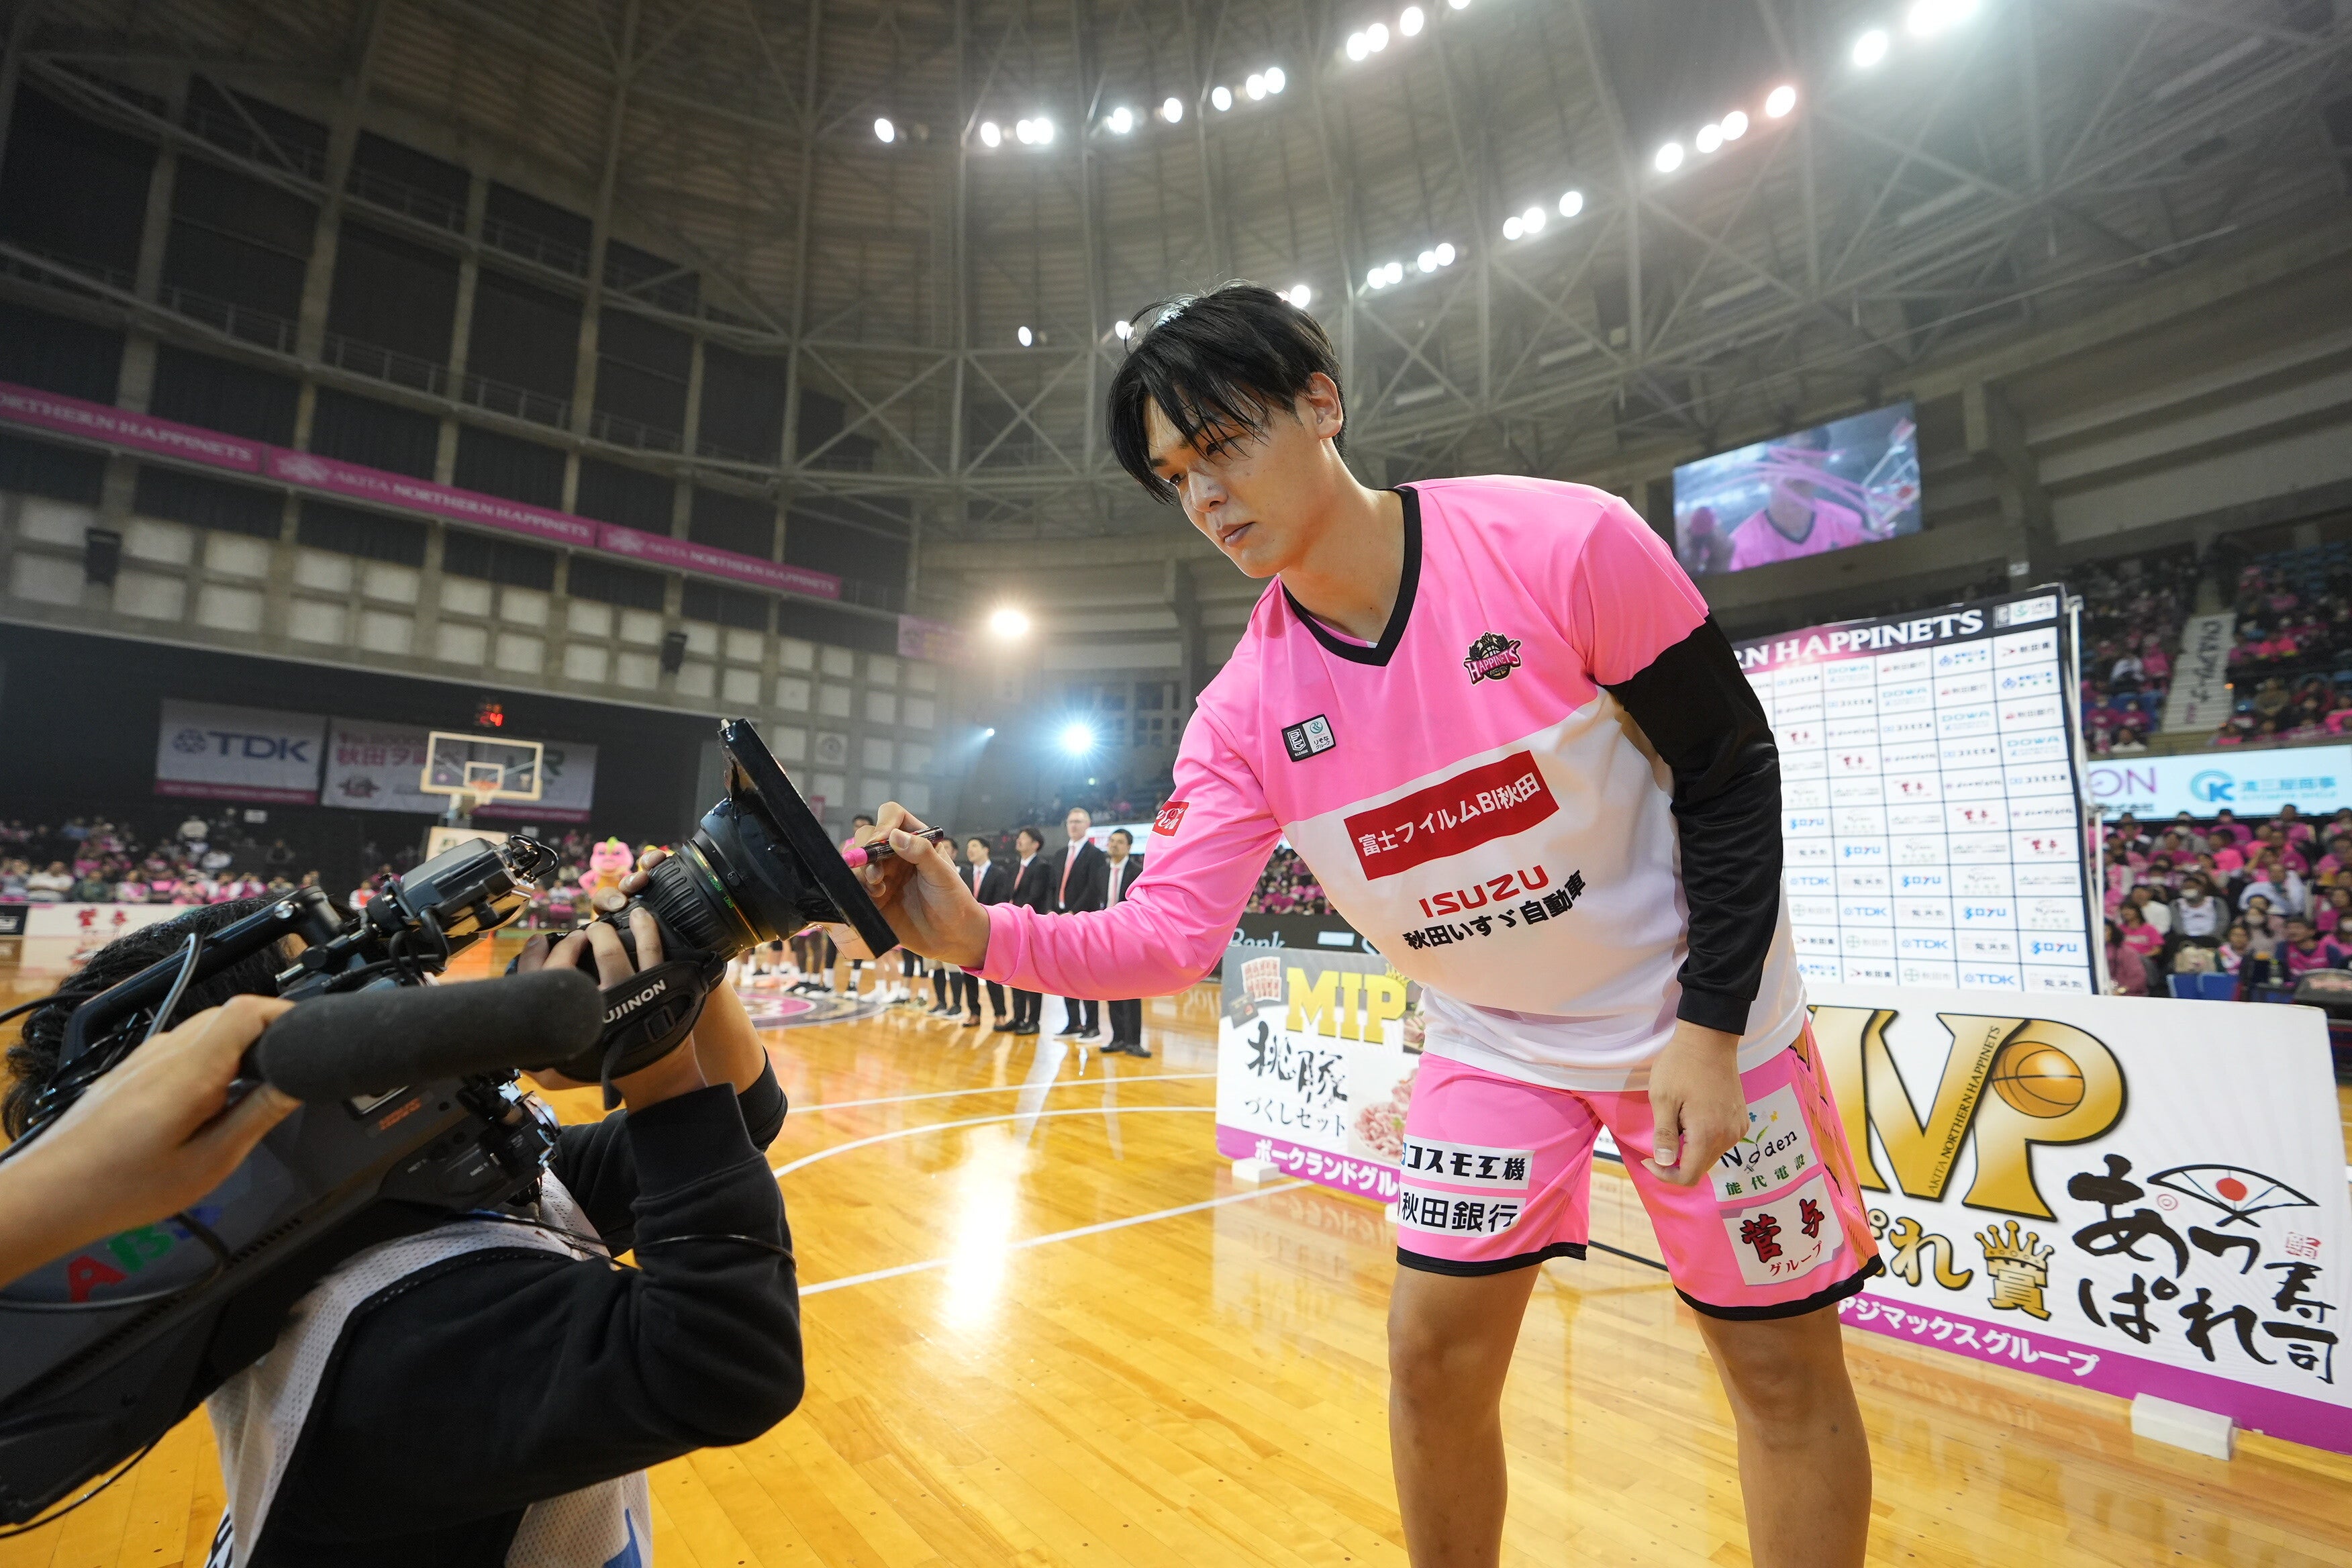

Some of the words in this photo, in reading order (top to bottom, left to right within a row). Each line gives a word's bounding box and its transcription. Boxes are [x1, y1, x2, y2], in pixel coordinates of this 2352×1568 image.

[1774, 609, 1984, 663] HAPPINETS
[1464, 640, 1520, 681] HAPPINETS
[206, 730, 311, 763] TDK
[1314, 736, 1329, 746] りそな
[1359, 772, 1541, 857] 富士フイルムBI秋田
[1418, 865, 1549, 918] ISUZU
[1800, 877, 1830, 886] TDK
[1402, 869, 1587, 950] 秋田いすゞ自動車
[1854, 907, 1887, 917] TDK
[1912, 940, 1949, 949] TDK
[1975, 973, 2016, 985] TDK
[1286, 967, 1408, 1045] MIP
[1245, 1096, 1345, 1136] づくしセット
[1928, 1161, 1948, 1194] AKITA
[1941, 1093, 1973, 1159] NORTHERN
[1966, 1025, 2001, 1093] HAPPINETS
[1254, 1138, 1400, 1197] ポークランドグル
[1407, 1144, 1526, 1181] コスモ工機
[1720, 1130, 1798, 1171] Noden
[1724, 1153, 1806, 1195] 能代電設
[1402, 1191, 1518, 1232] 秋田銀行
[1769, 1240, 1822, 1277] グループ
[2261, 1261, 2339, 1385] 寿司
